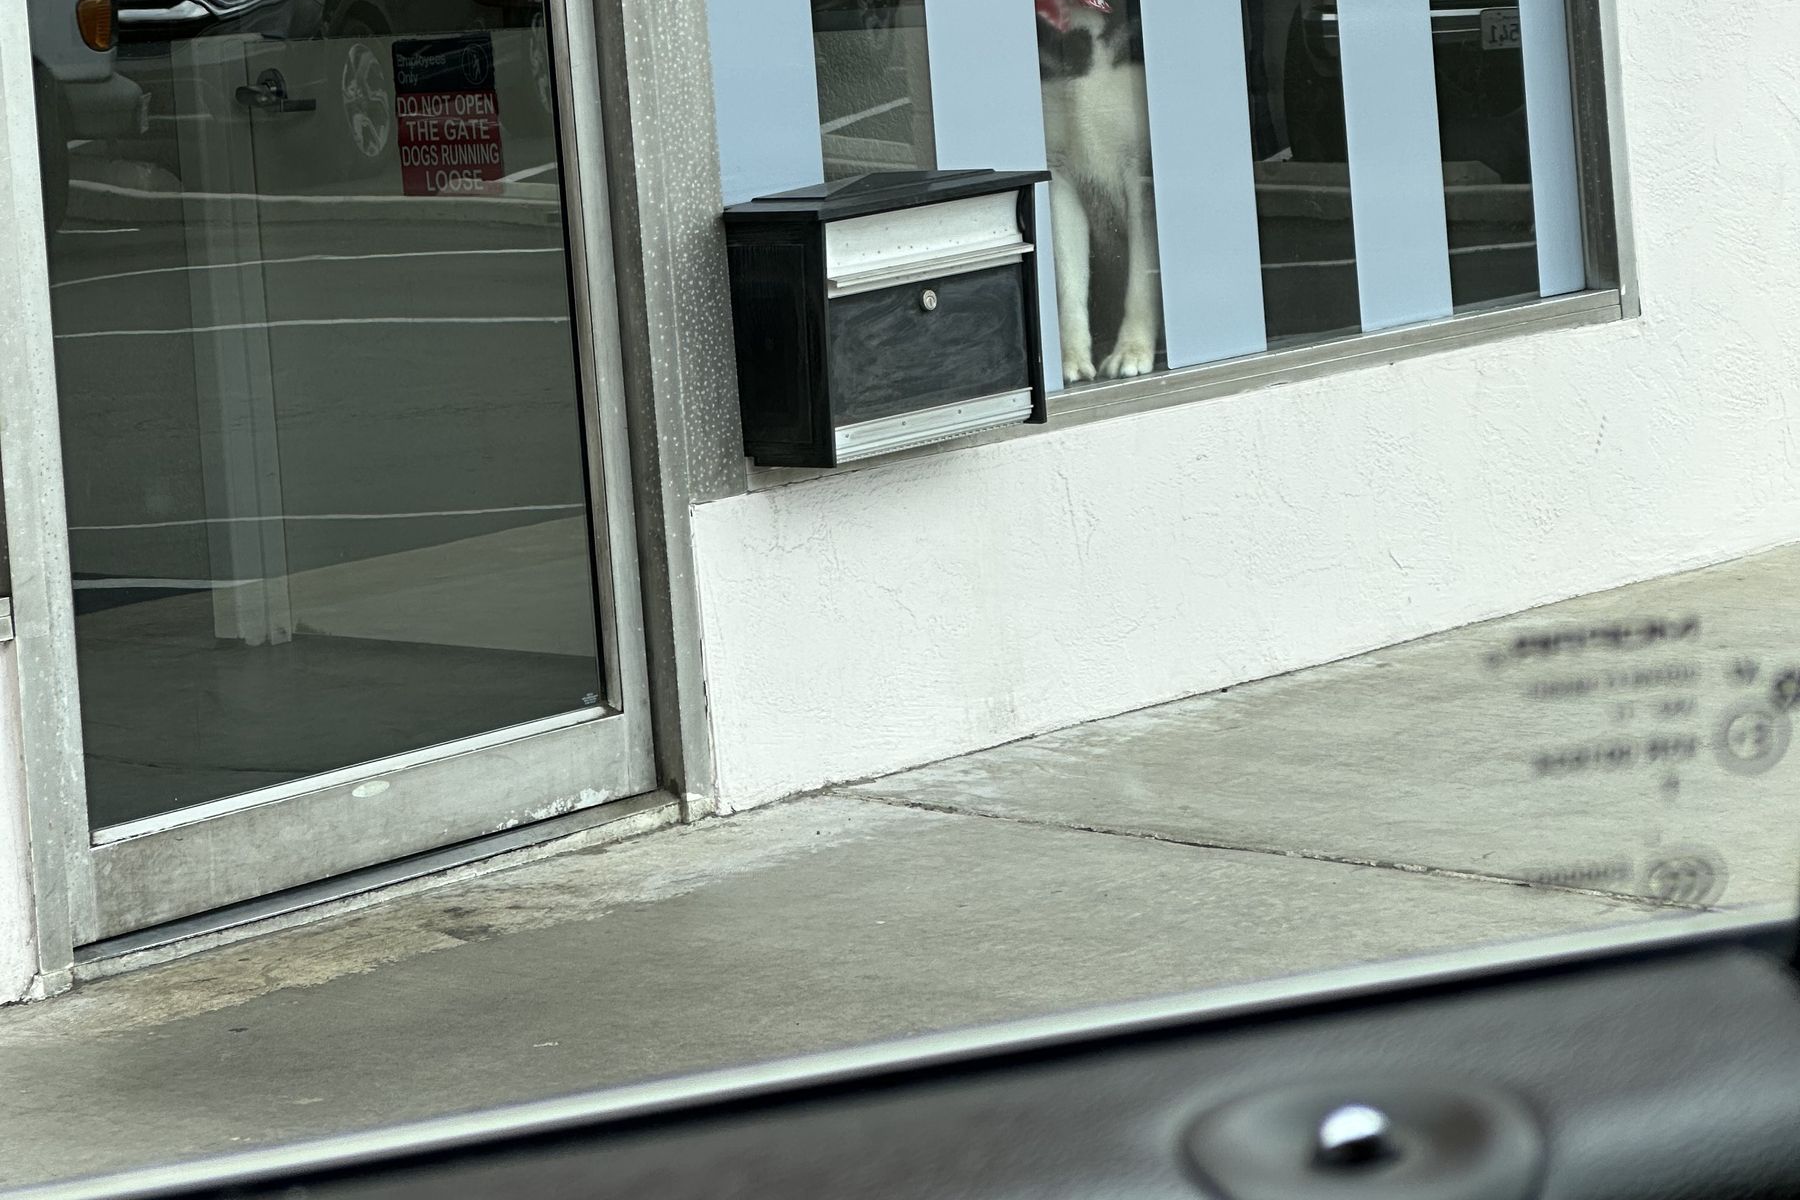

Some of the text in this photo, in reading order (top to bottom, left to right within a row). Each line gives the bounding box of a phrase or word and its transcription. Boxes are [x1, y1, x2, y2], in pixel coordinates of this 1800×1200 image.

[397, 71, 419, 86] Only
[397, 94, 495, 116] DO NOT OPEN
[406, 119, 491, 142] THE GATE
[401, 143, 500, 166] DOGS RUNNING
[425, 170, 485, 192] LOOSE
